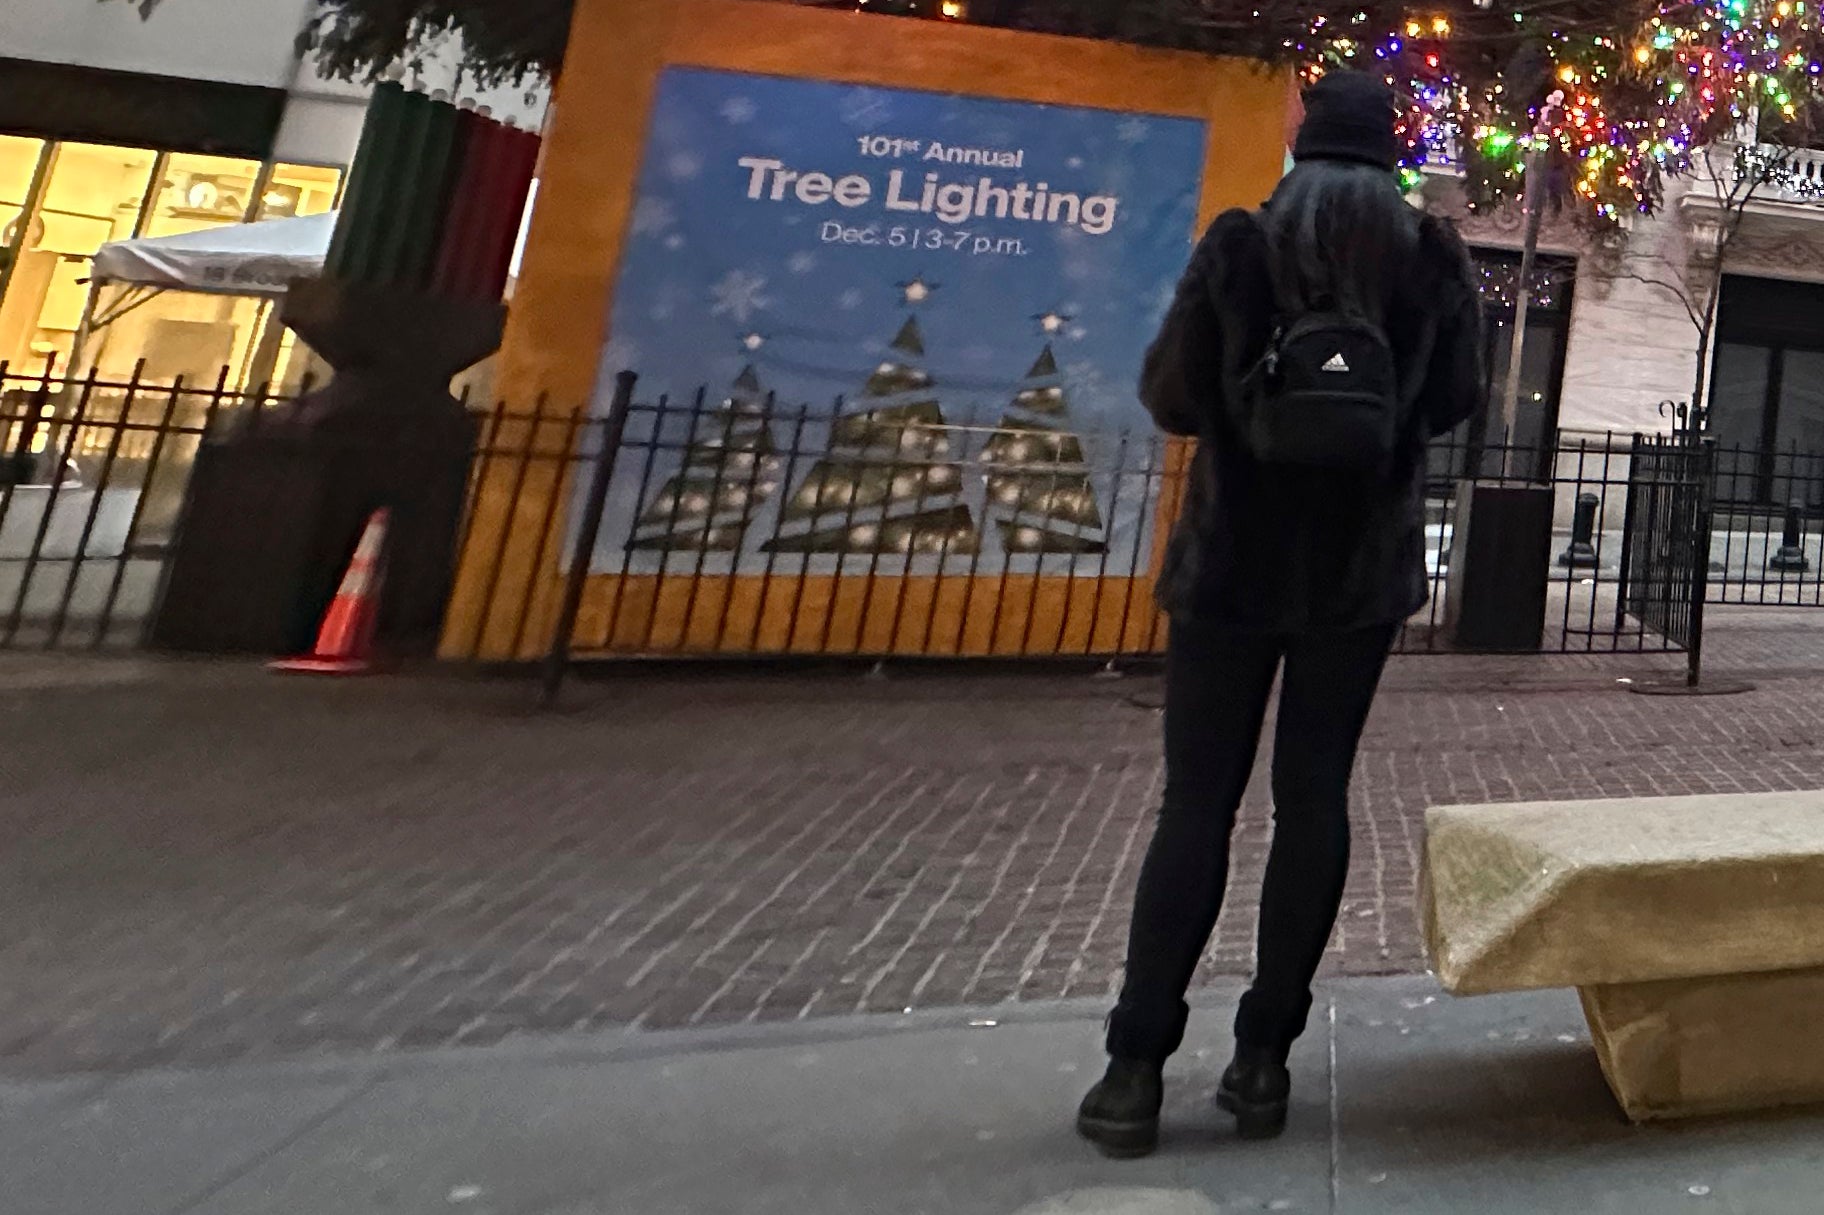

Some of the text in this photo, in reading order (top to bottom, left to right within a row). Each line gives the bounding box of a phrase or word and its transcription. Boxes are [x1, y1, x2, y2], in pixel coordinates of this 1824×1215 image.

[922, 142, 1024, 168] Annual
[738, 157, 1117, 235] Tree Lighting
[821, 221, 880, 245] Dec.
[888, 227, 906, 247] 5
[925, 229, 971, 251] 3-7
[973, 236, 1028, 256] p.m.
